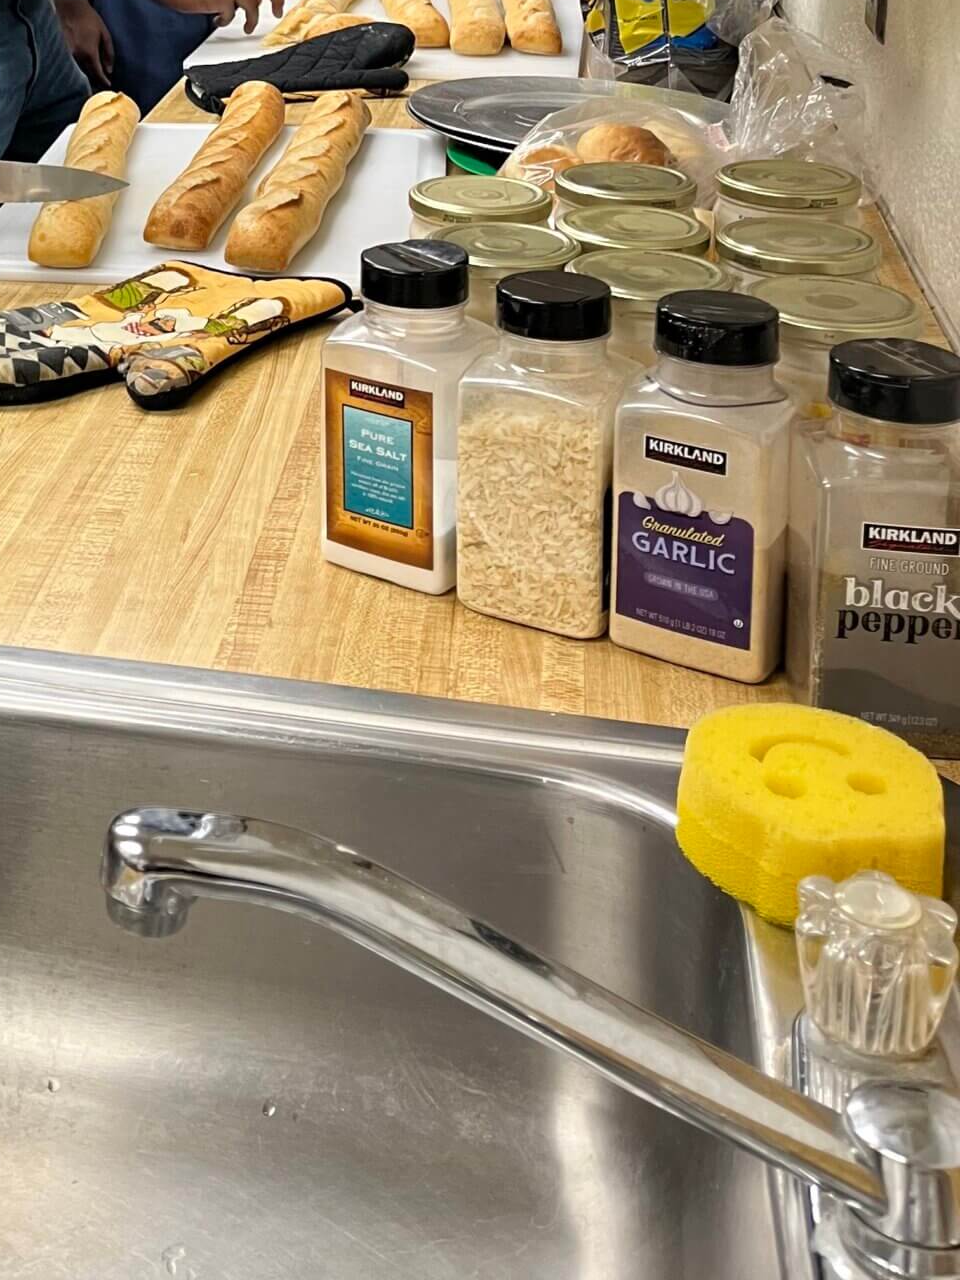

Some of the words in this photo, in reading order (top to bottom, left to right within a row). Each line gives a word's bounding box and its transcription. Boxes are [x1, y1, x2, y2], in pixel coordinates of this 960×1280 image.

[351, 380, 404, 402] KIRKLAND
[361, 428, 395, 446] PURE
[349, 439, 373, 454] SEA
[375, 446, 407, 462] SALT
[648, 439, 724, 465] KIRKLAND
[642, 515, 726, 548] Granulated
[868, 526, 958, 545] KIRKLAND
[631, 531, 737, 575] GARLIC
[870, 557, 897, 572] FINE
[900, 560, 950, 576] GROUND
[684, 583, 697, 596] THE
[844, 576, 960, 621] black
[635, 607, 648, 617] NET
[835, 607, 960, 645] peppe
